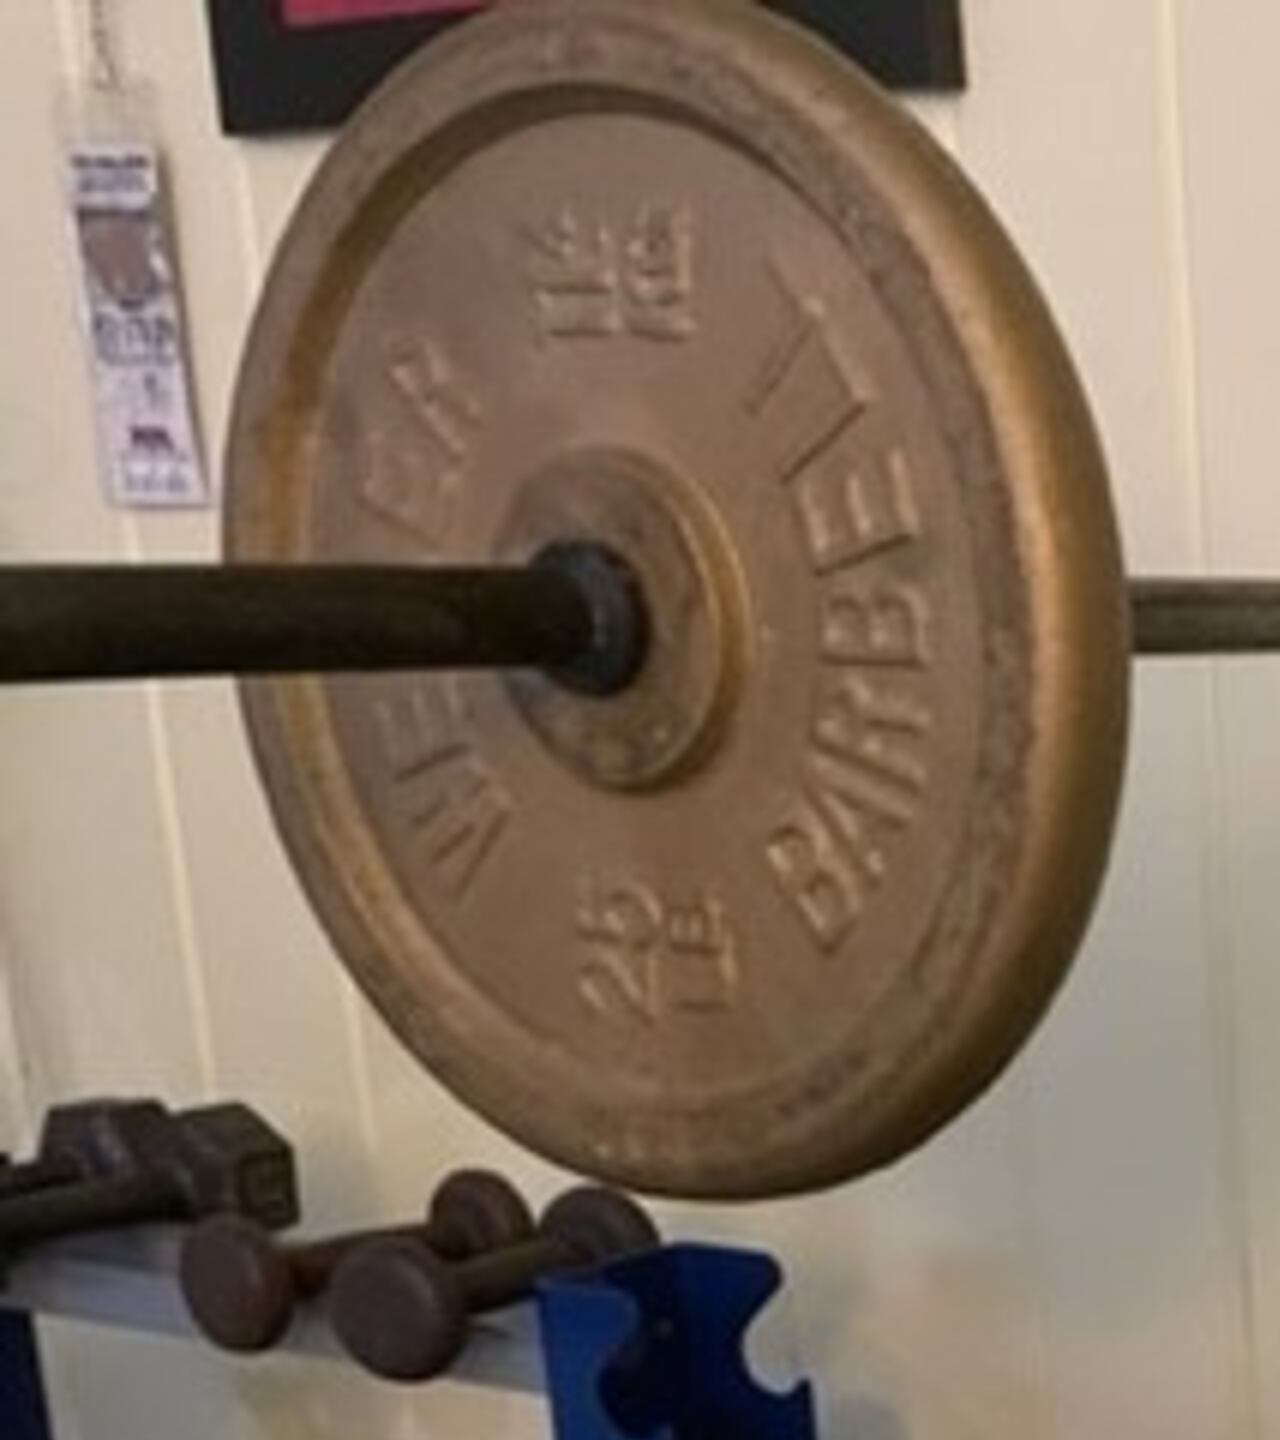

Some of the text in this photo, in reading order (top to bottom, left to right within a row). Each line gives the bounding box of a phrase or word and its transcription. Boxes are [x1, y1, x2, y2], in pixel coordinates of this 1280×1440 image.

[353, 334, 513, 902] WEER
[743, 255, 932, 958] BARBELL
[574, 872, 662, 1030] 25
